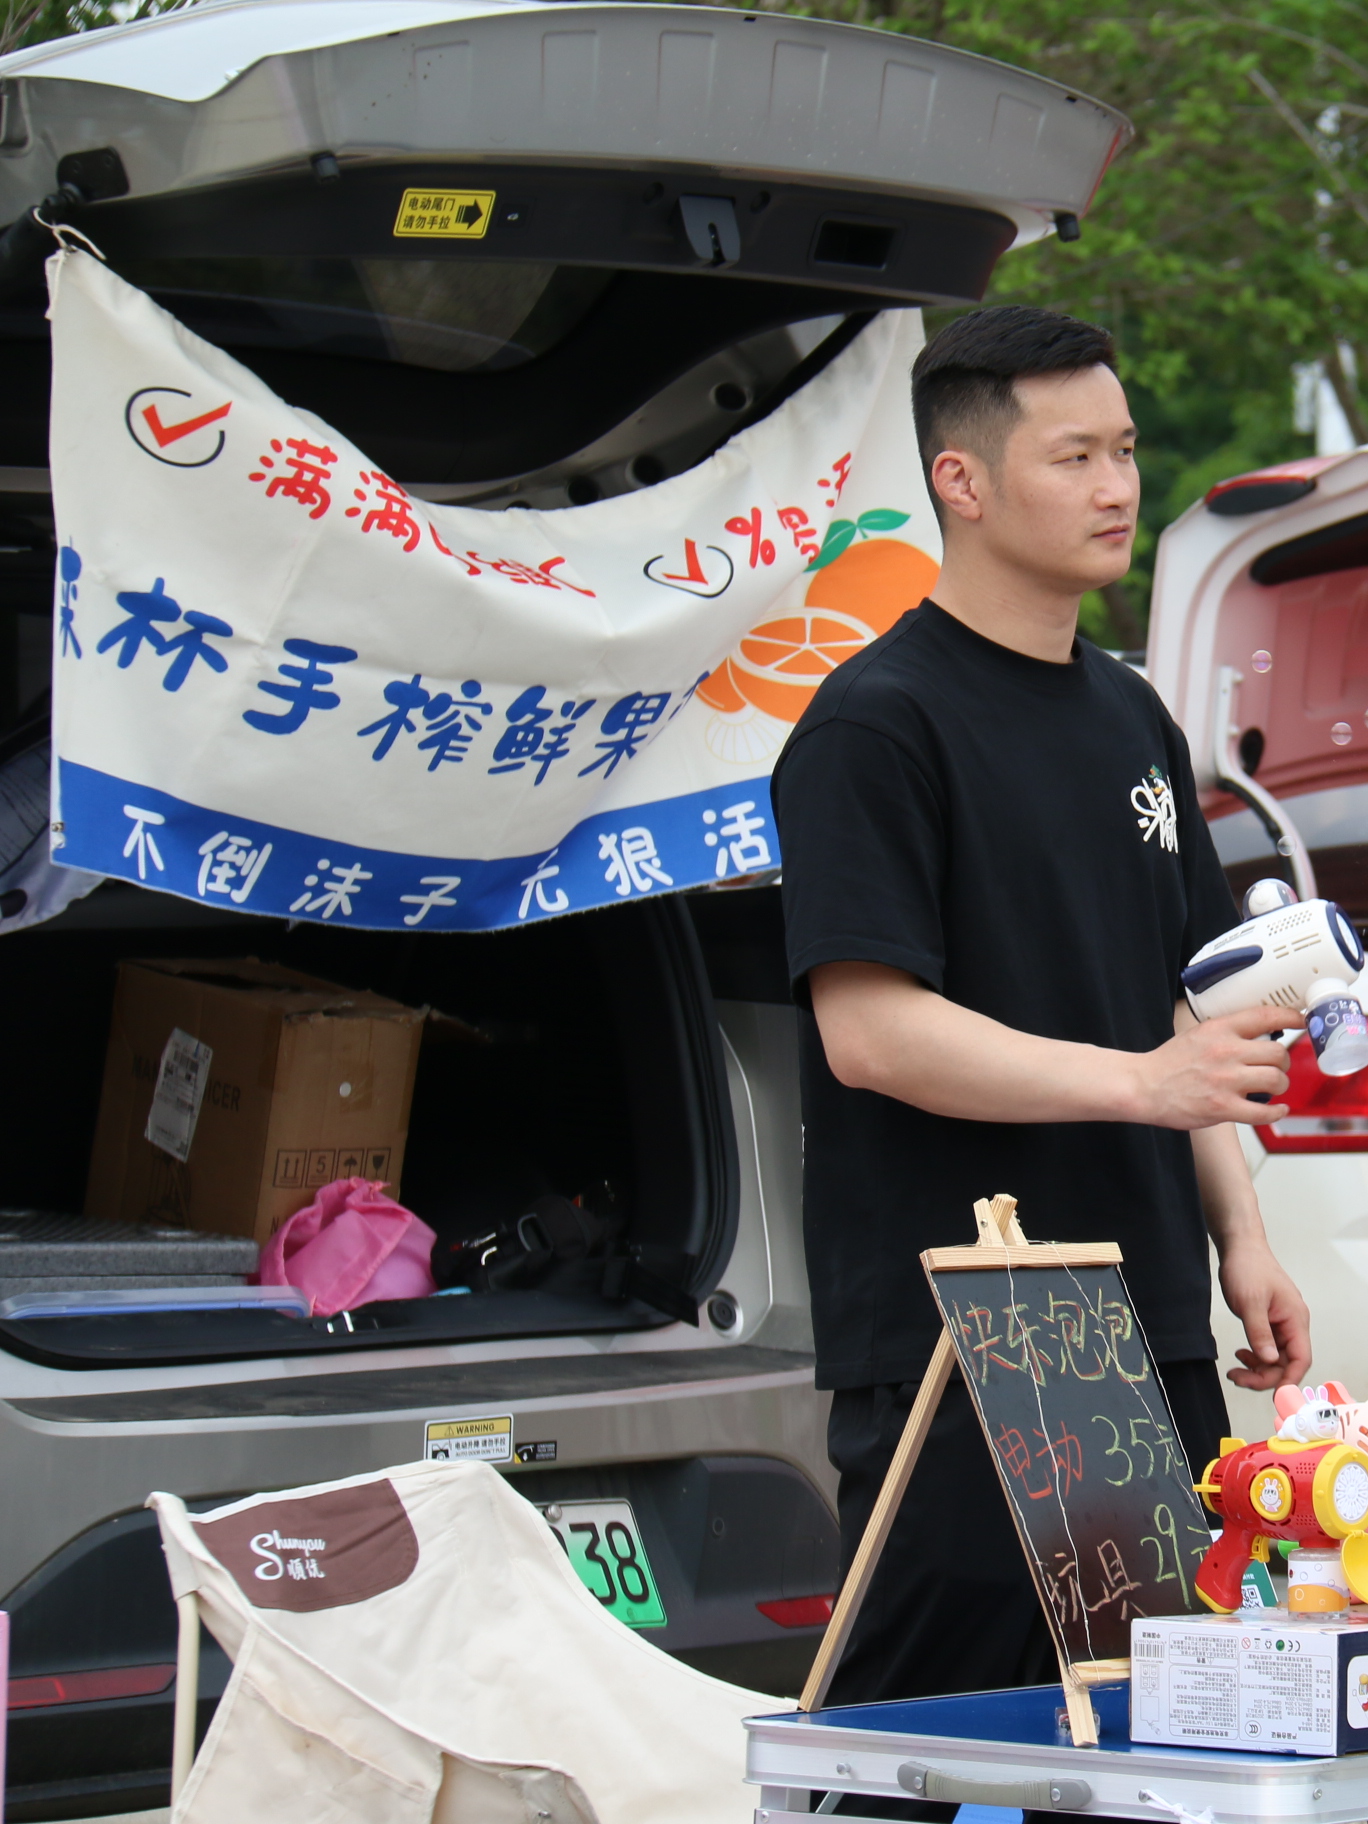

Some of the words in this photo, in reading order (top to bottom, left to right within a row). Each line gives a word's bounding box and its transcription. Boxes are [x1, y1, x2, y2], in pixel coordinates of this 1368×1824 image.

[402, 214, 451, 230] 请勿手拉
[408, 196, 456, 212] 电动尾门
[60, 536, 710, 787] 杯手榨鲜果
[952, 1288, 1150, 1388] 快乐泡泡
[456, 1422, 495, 1435] WARNING
[994, 1421, 1083, 1500] 电动
[1091, 1415, 1184, 1487] 35元
[249, 1529, 326, 1581] Shunyou
[549, 1521, 650, 1606] 38
[1035, 1539, 1149, 1626] 玩具
